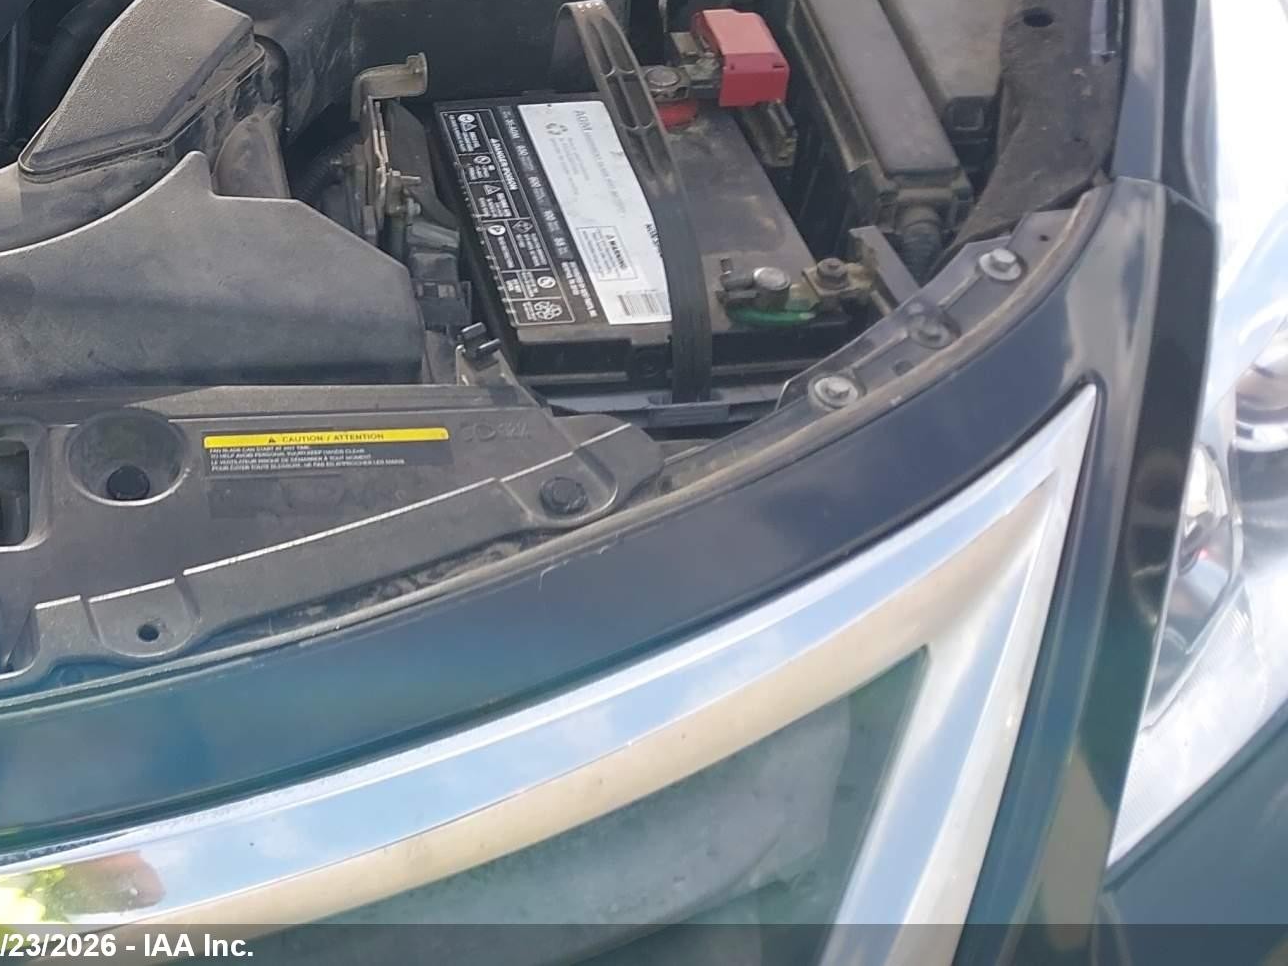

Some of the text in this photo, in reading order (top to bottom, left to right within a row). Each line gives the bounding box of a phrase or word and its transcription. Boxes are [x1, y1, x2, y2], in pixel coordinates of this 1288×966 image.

[610, 240, 629, 271] WARNING
[282, 435, 323, 443] CAUTION
[333, 432, 384, 441] ATTENTION
